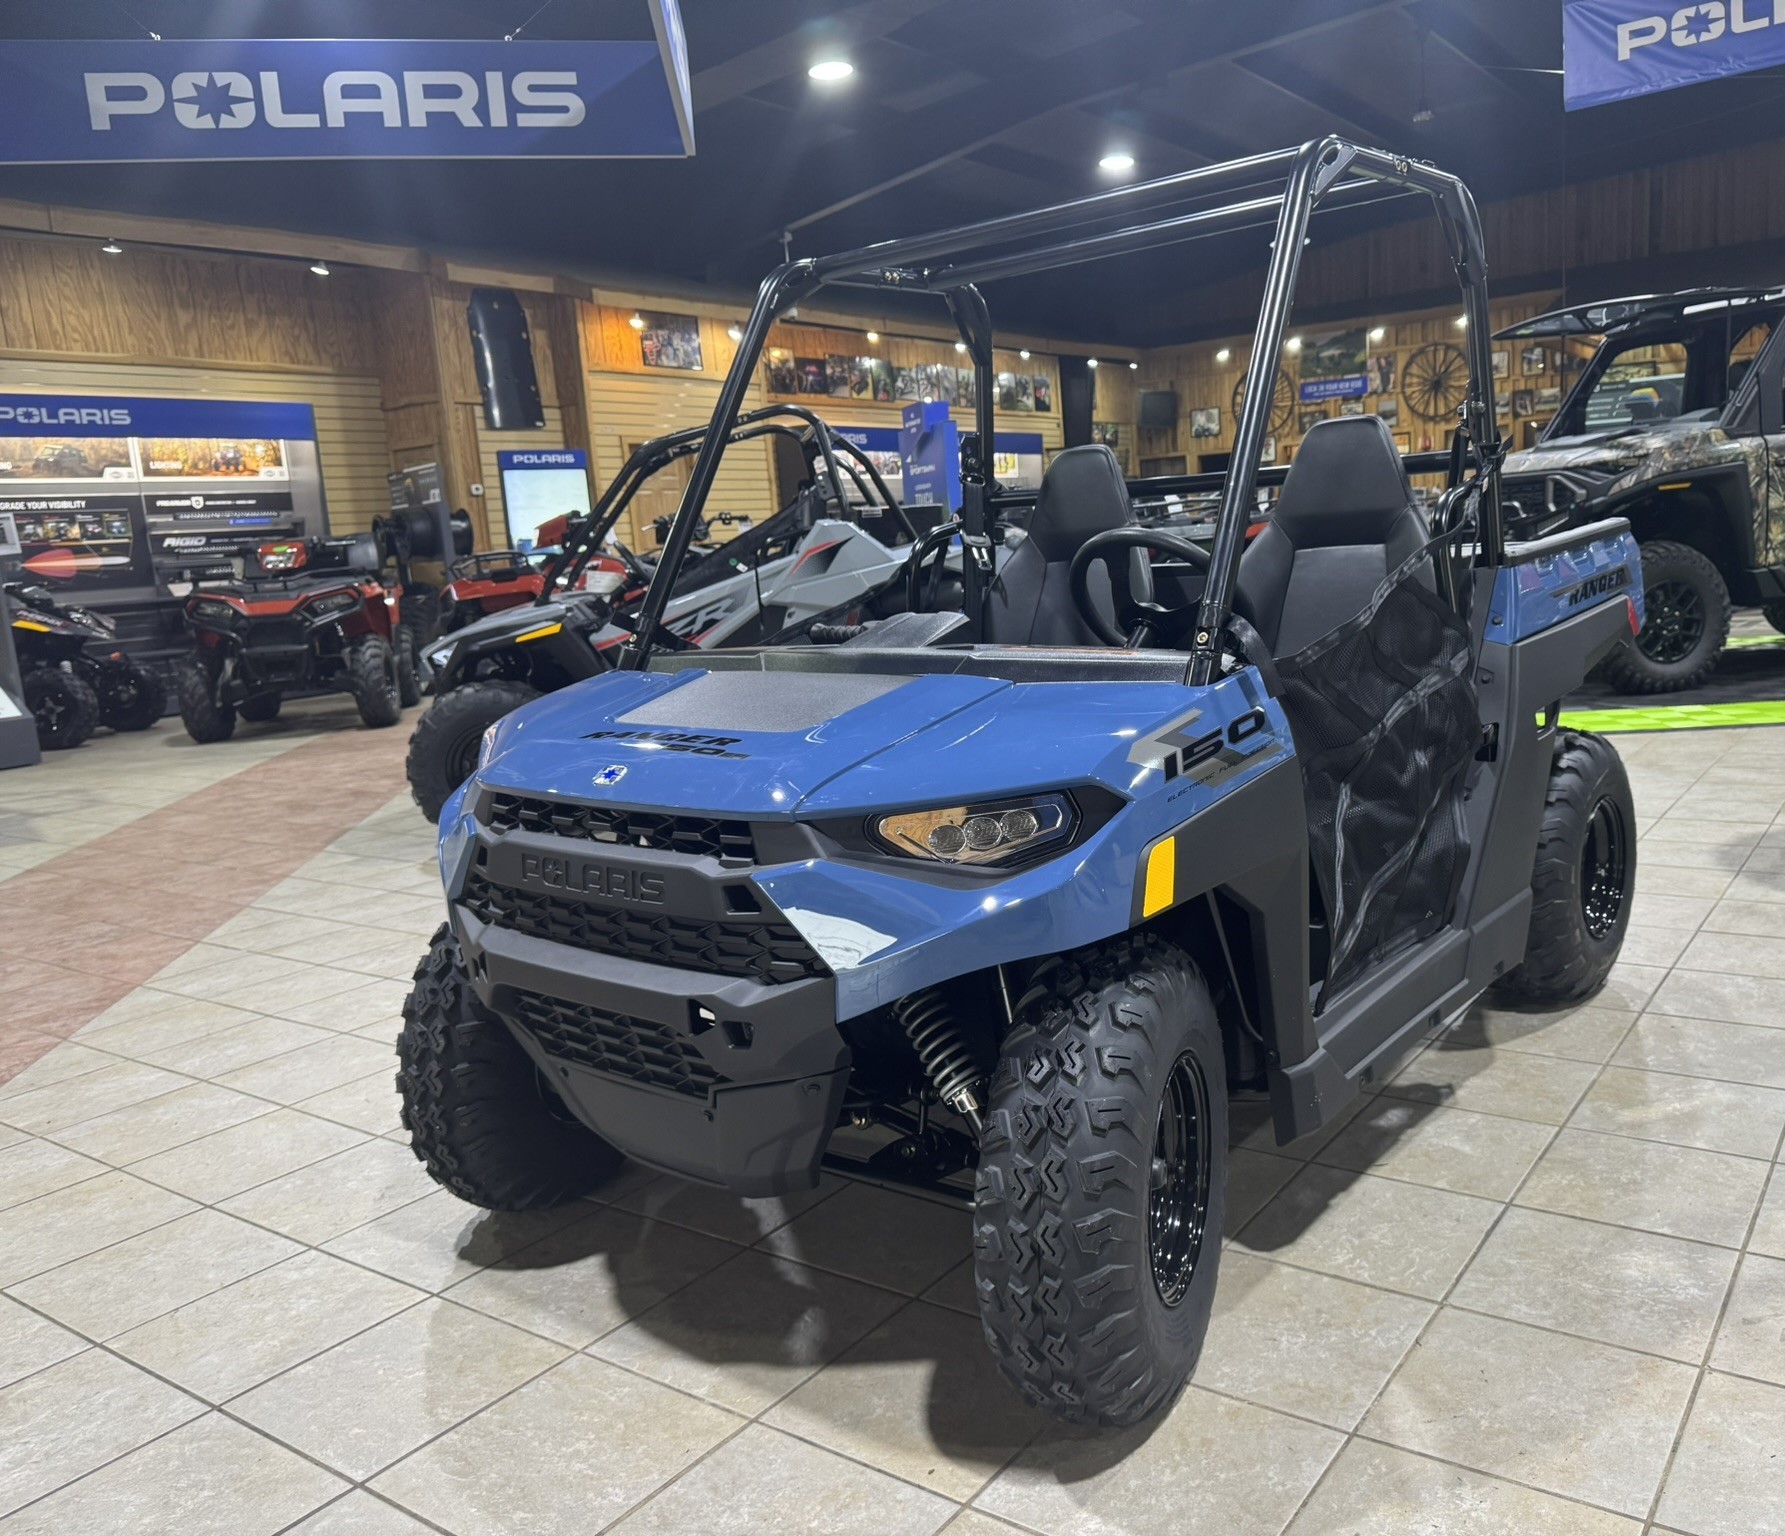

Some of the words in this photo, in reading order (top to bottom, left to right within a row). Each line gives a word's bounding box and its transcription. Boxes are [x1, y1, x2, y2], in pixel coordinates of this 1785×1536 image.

[84, 71, 586, 130] POLARIS
[512, 454, 575, 464] POLARIS
[26, 501, 48, 510] YOUR
[47, 500, 86, 510] VISIBILITY
[163, 536, 207, 548] RIGID
[1568, 566, 1625, 607] RANGER
[579, 731, 743, 747] RANGER
[1163, 706, 1266, 784] 150
[1167, 771, 1216, 803] ELECTRONIC
[521, 853, 665, 905] POLARIS
